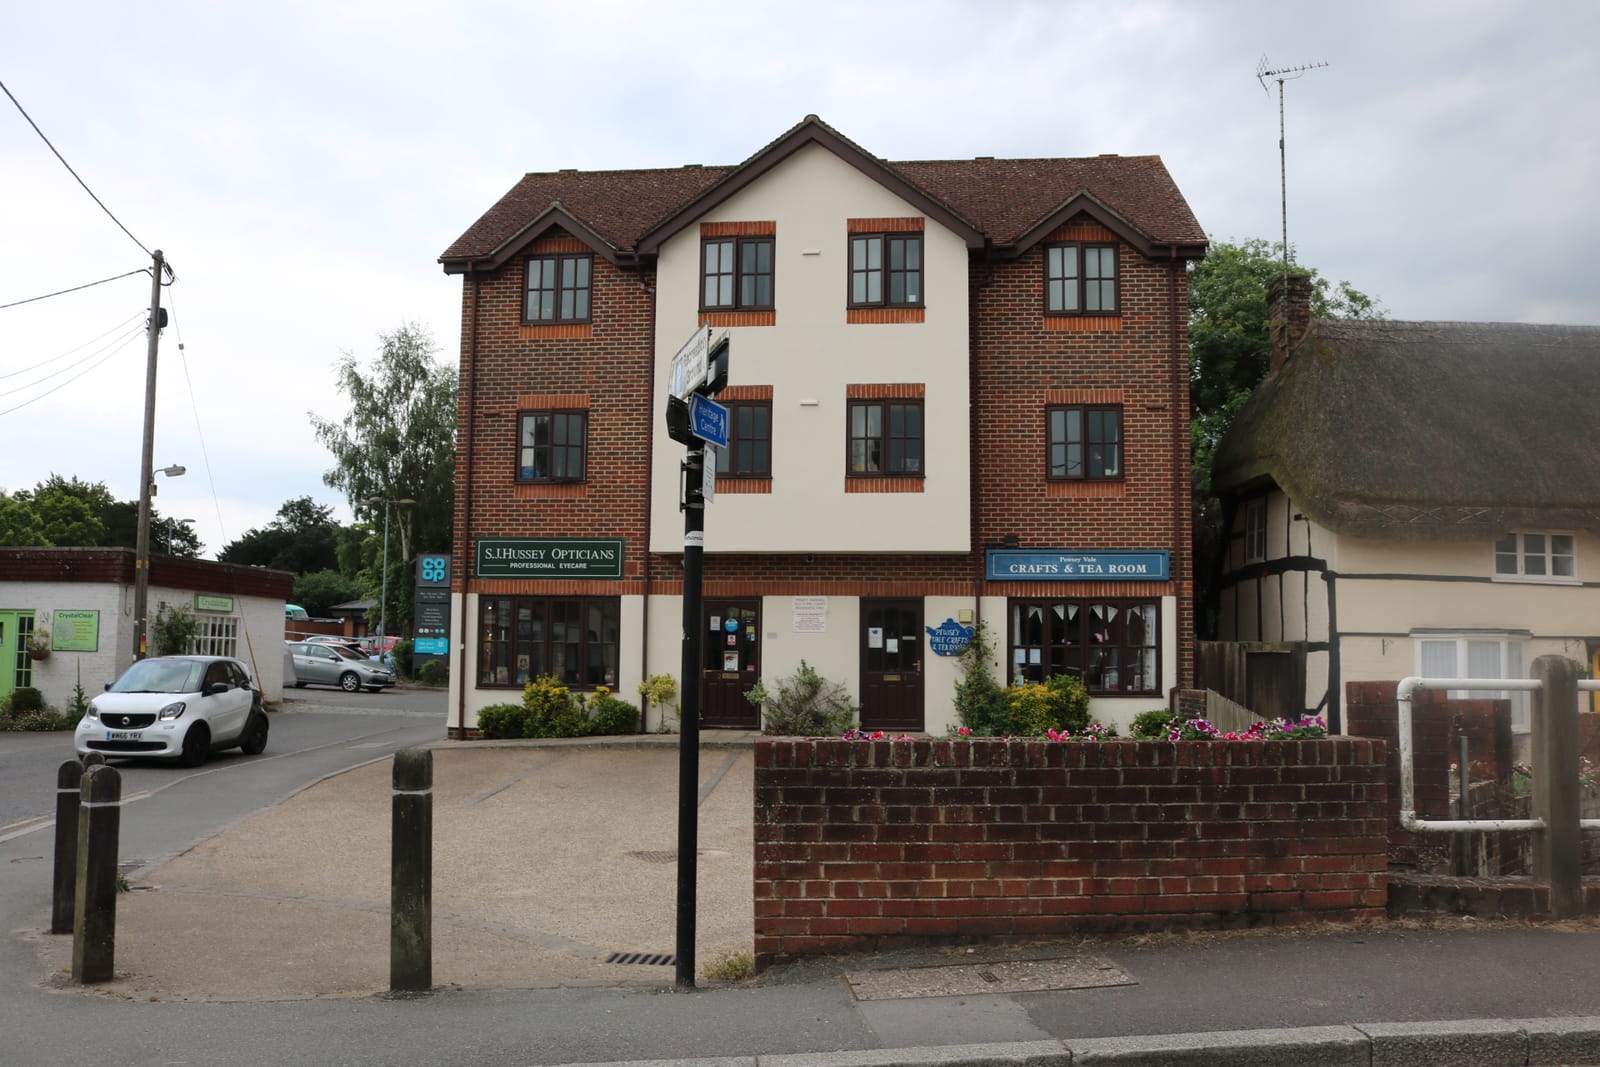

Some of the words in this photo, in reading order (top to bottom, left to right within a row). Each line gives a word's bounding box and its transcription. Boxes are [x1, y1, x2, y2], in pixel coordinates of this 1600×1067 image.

[698, 402, 719, 424] Heritage
[700, 418, 717, 436] Centre
[552, 548, 615, 560] OPTICIANS
[1009, 564, 1059, 574] CRAFTS
[1064, 564, 1073, 573] &
[1079, 564, 1104, 573] TEA
[1108, 564, 1148, 574] ROOM
[946, 636, 969, 645] CRAFTS
